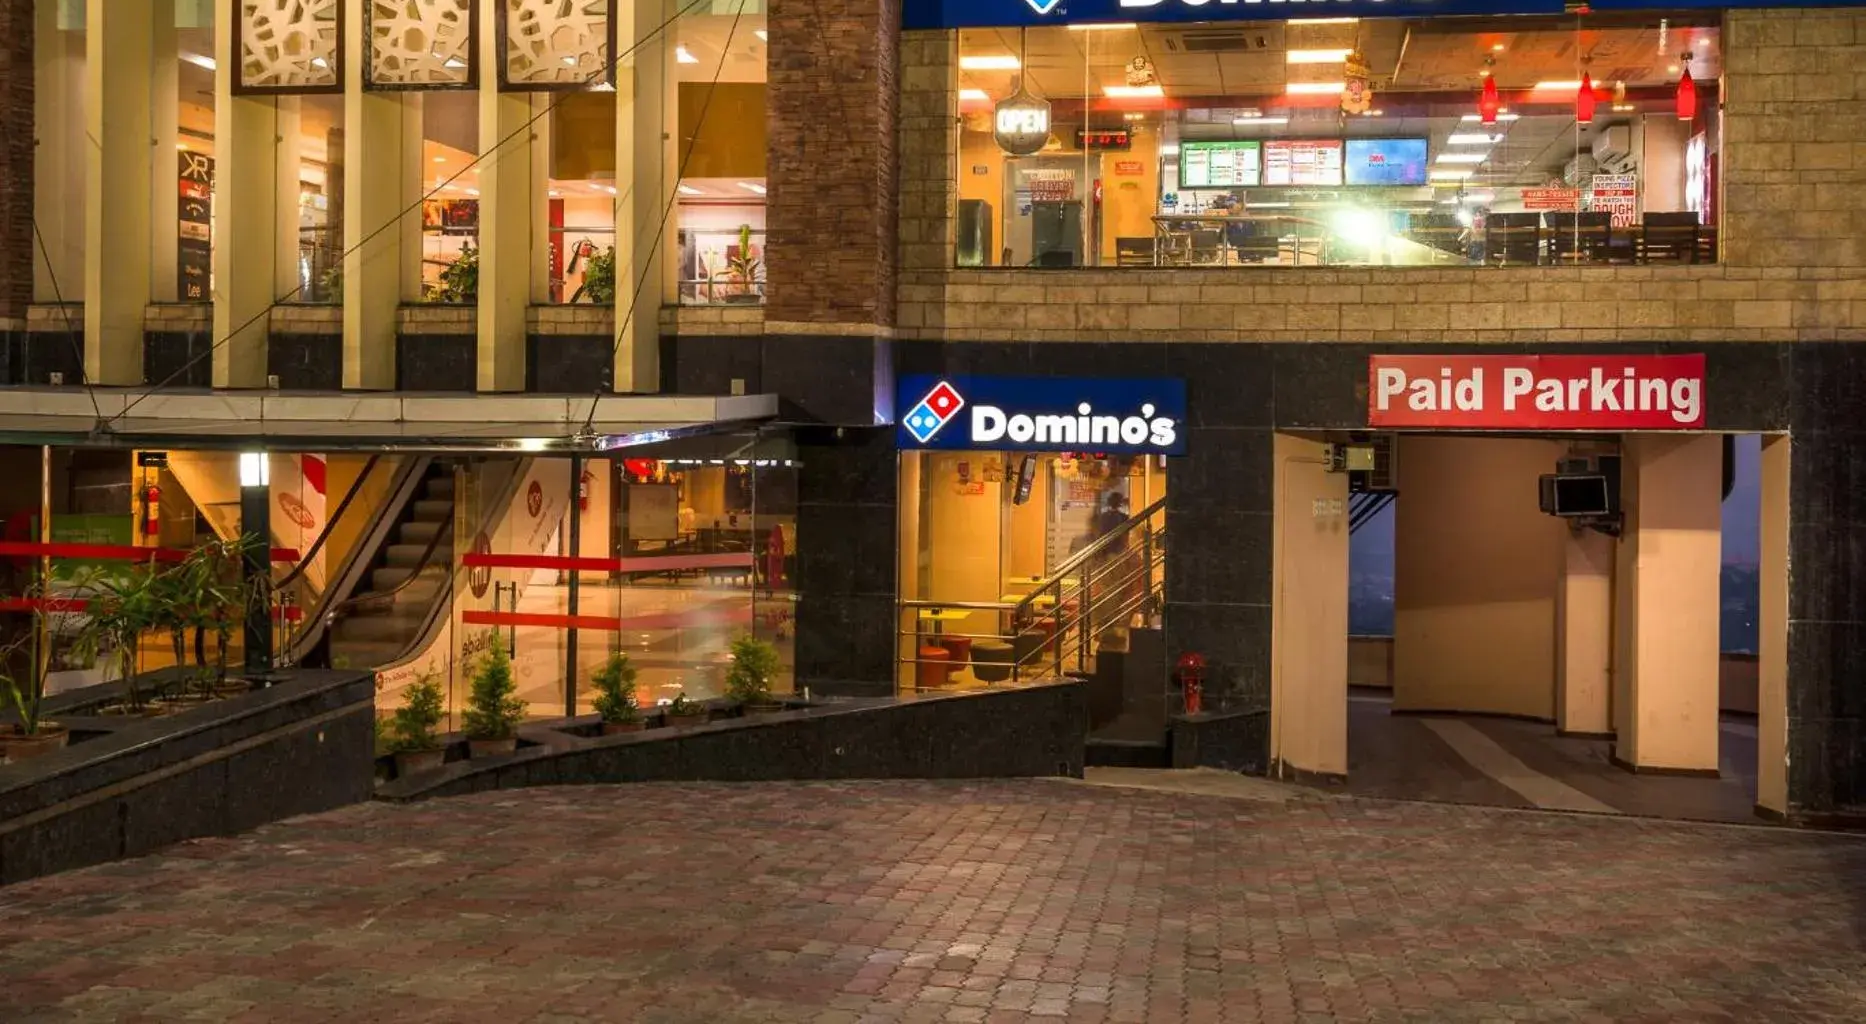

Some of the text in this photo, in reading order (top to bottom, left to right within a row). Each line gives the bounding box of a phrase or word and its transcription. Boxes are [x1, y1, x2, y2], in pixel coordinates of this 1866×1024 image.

[997, 108, 1048, 133] OPEN
[187, 283, 201, 298] Lee
[1376, 367, 1701, 423] Paid Parking
[971, 402, 1176, 446] Domino's
